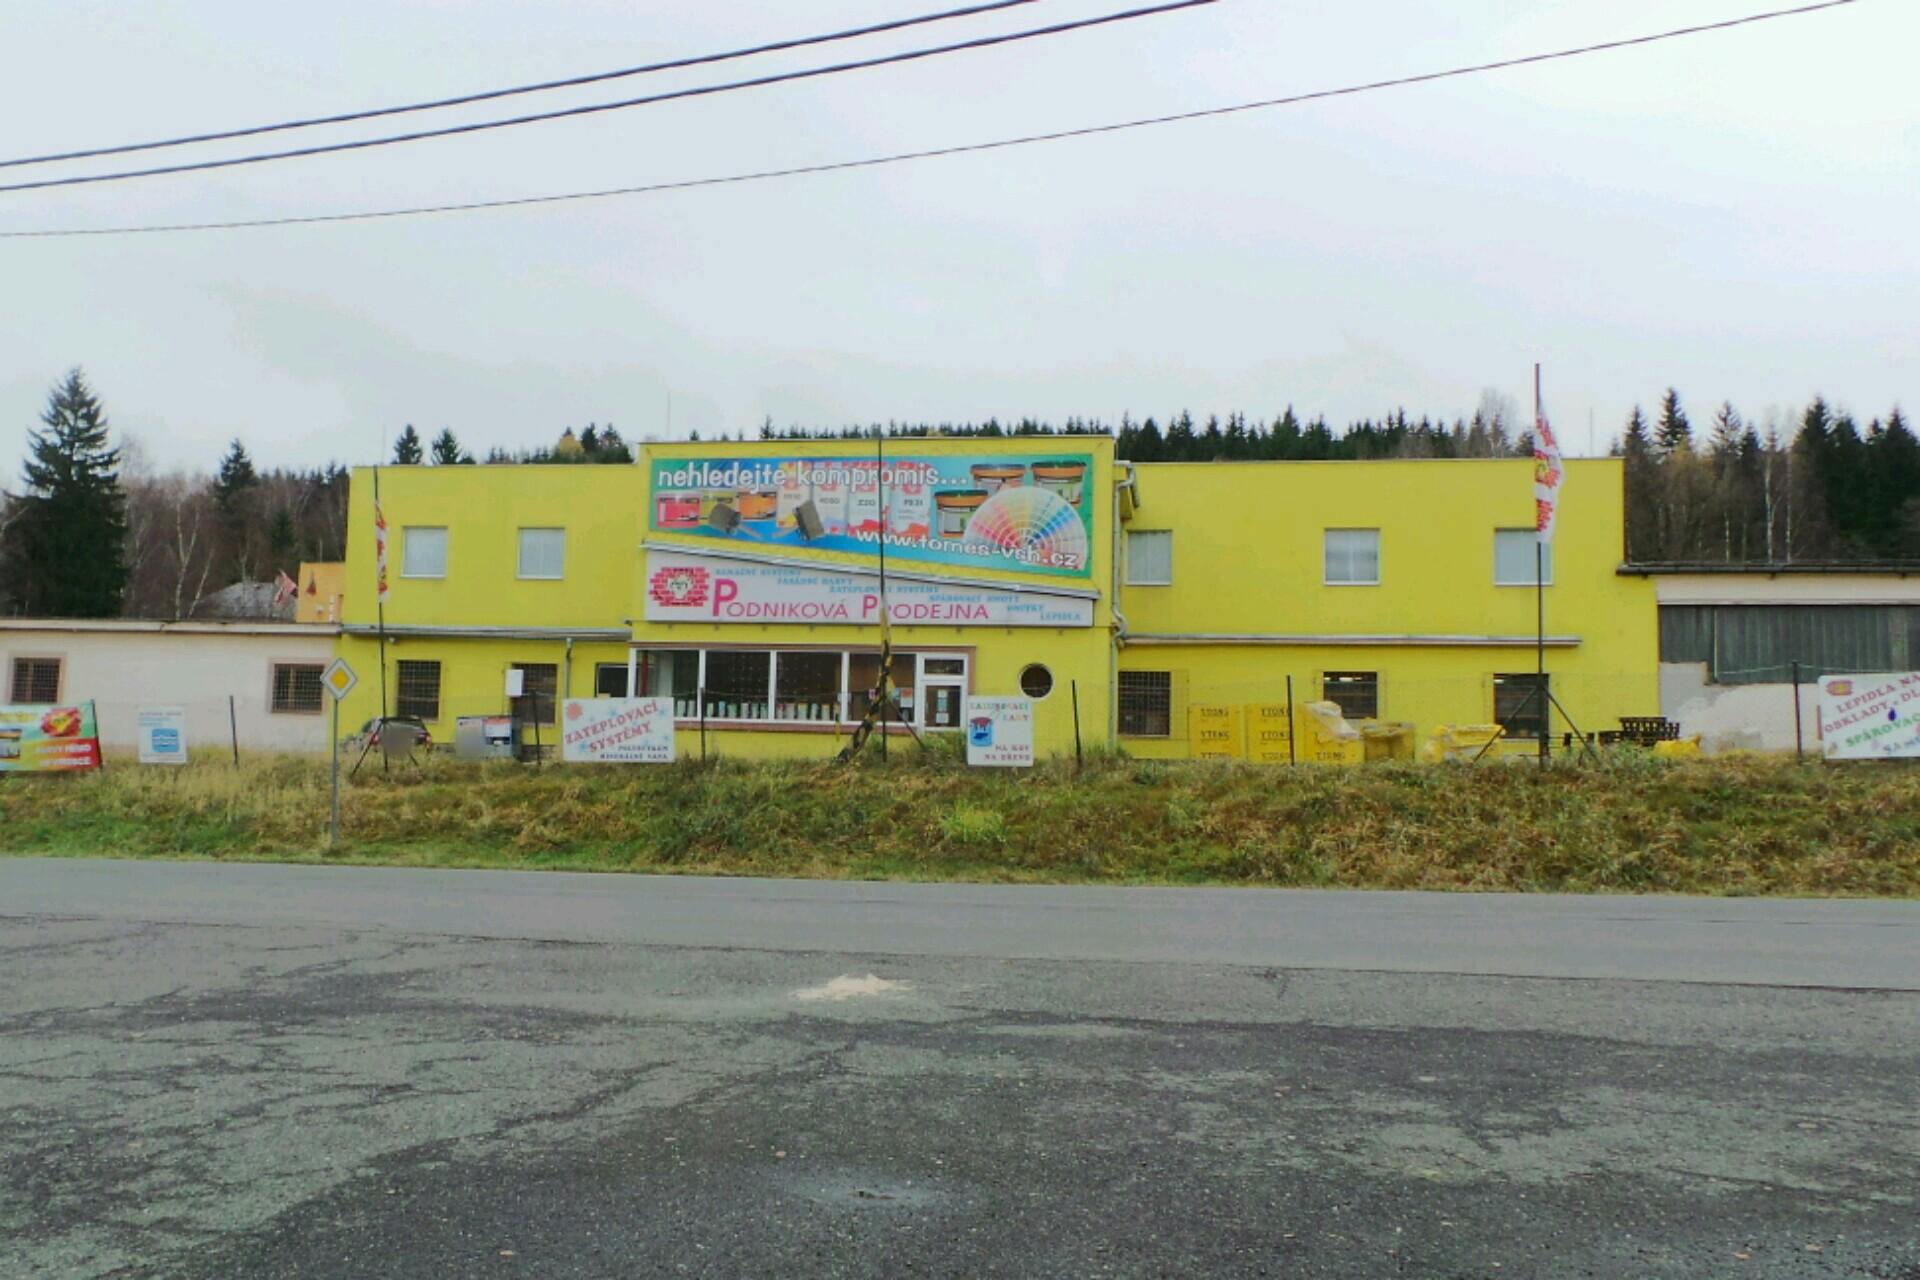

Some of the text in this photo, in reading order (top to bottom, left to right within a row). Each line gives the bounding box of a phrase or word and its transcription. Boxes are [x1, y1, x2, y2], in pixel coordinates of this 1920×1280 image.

[658, 461, 968, 494] nehledejte kompromis...
[856, 528, 1078, 566] www.tomes-vsh.cz
[712, 578, 849, 618] PODNIKOVÁ
[1836, 685, 1896, 713] LEPIDLA
[564, 699, 658, 745] ZATEPLOVACÍ
[588, 721, 652, 753] SYSTÉMY
